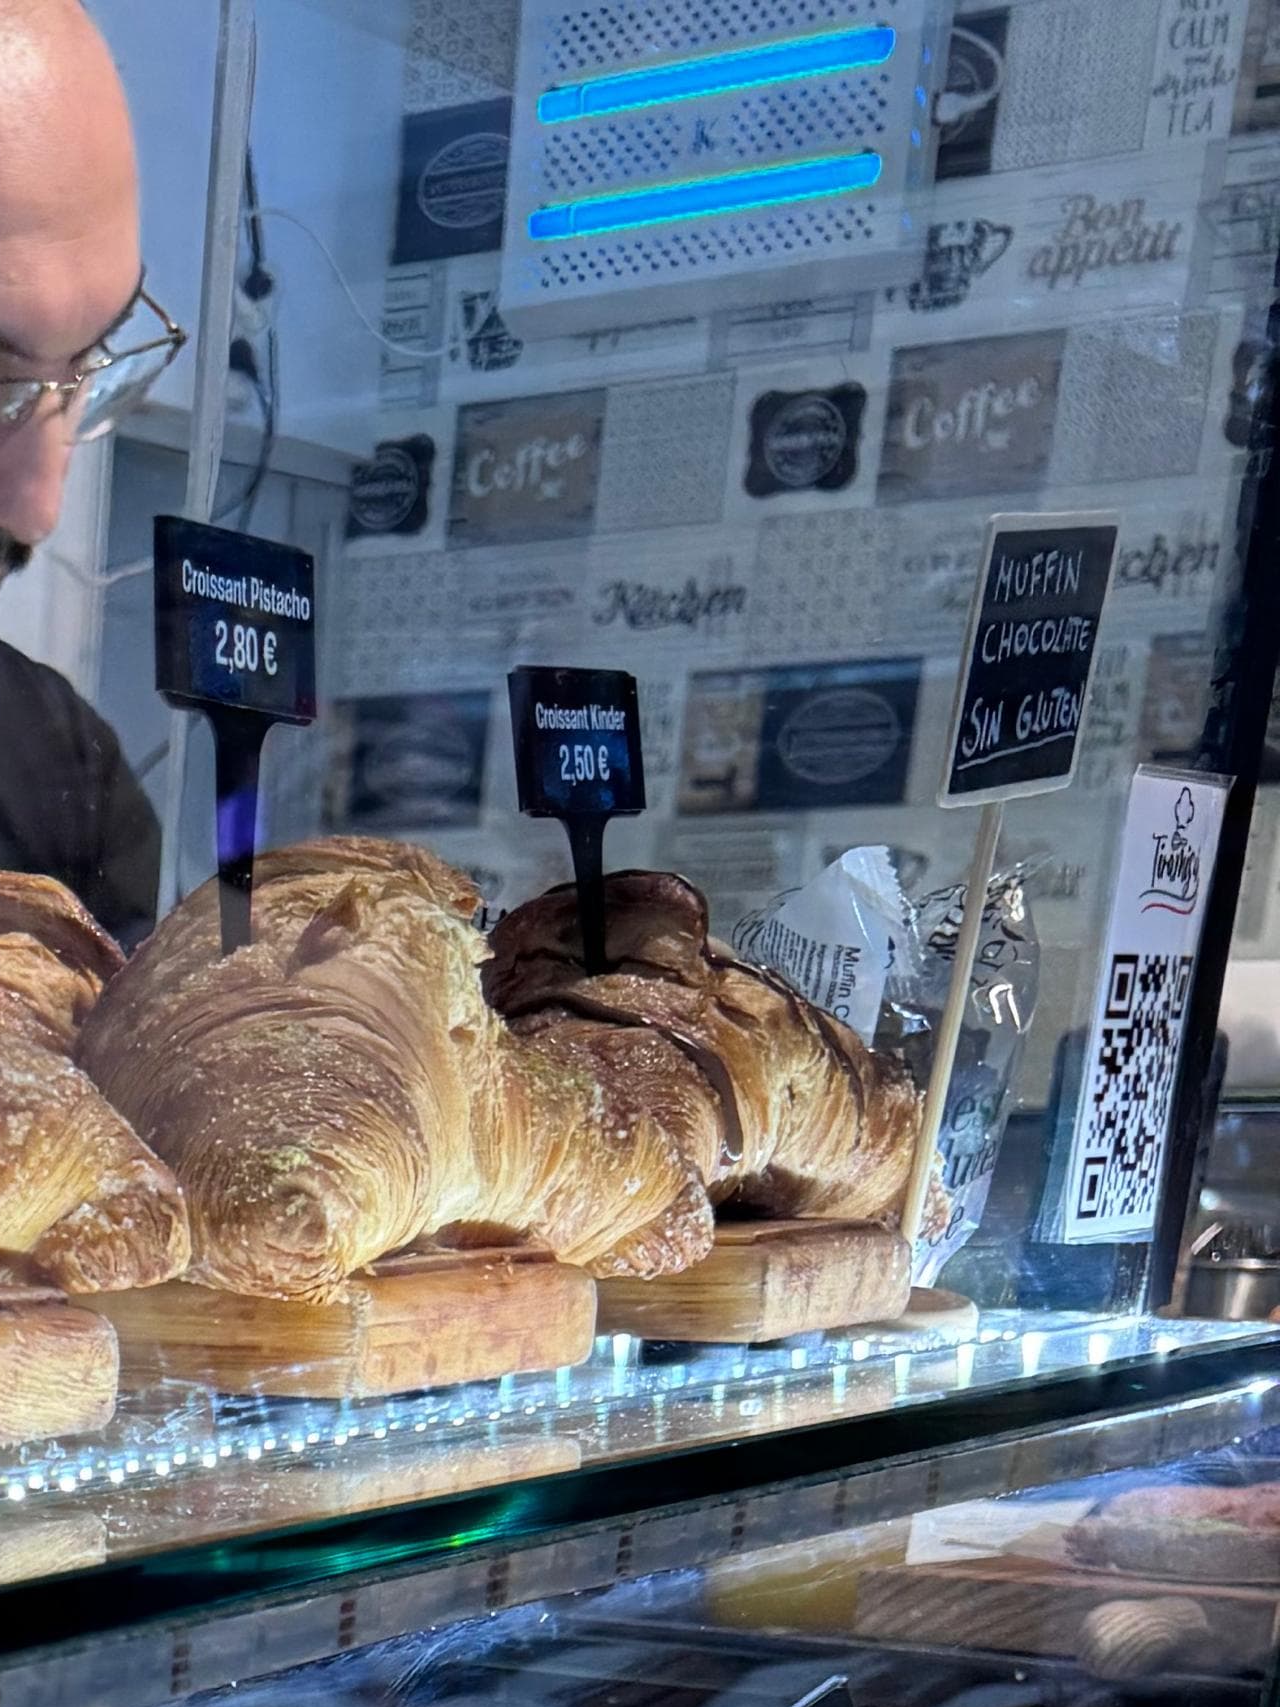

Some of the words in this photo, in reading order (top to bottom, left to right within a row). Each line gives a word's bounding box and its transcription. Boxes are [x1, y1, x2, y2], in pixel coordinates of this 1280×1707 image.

[905, 376, 1040, 451] Coffee
[466, 431, 588, 498] Coffee
[182, 558, 248, 608] Croissant
[250, 576, 311, 622] Pistacho
[993, 549, 1084, 603] MUFFIN
[214, 619, 260, 675] 2,80
[263, 631, 279, 676] €
[980, 615, 1092, 665] CHOCOLATE
[535, 701, 590, 732] Croissant
[590, 703, 627, 732] Kinder
[961, 696, 1005, 758] SIN
[1014, 680, 1088, 742] GLUTEN
[558, 743, 596, 787] 2,50
[598, 744, 611, 783] €
[838, 945, 862, 999] Muffin
